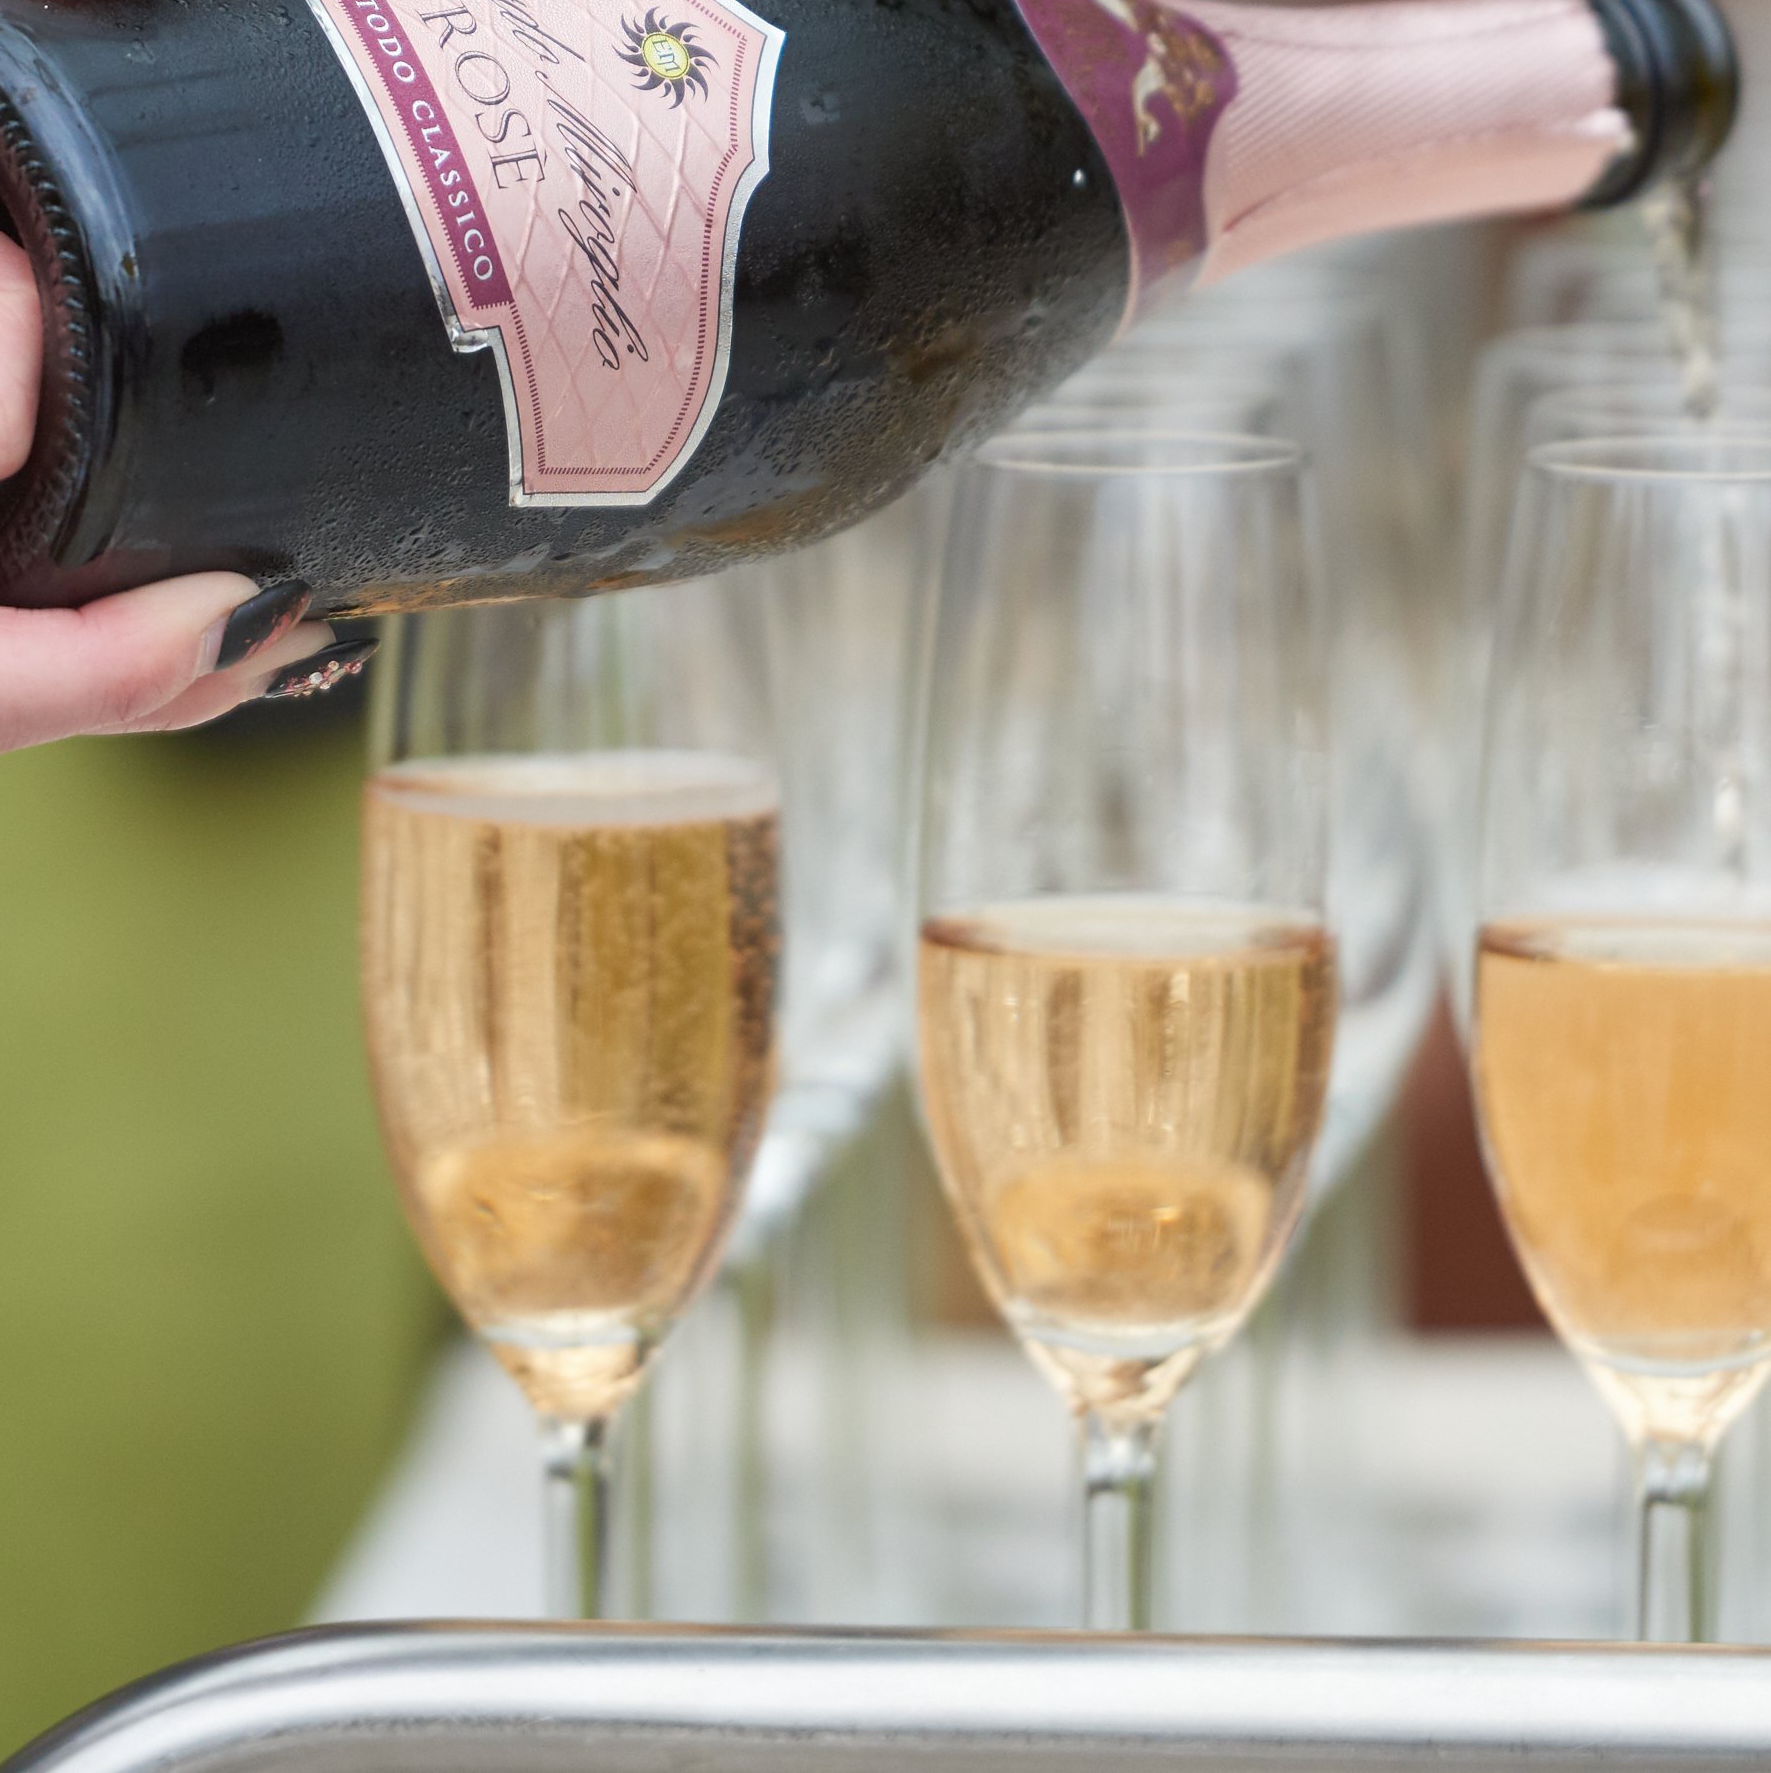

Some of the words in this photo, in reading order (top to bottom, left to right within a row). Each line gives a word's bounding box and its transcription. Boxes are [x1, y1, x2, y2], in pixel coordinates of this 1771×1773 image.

[652, 39, 682, 72] EM
[412, 99, 495, 283] CLASSICO
[535, 69, 649, 372] Miroglio
